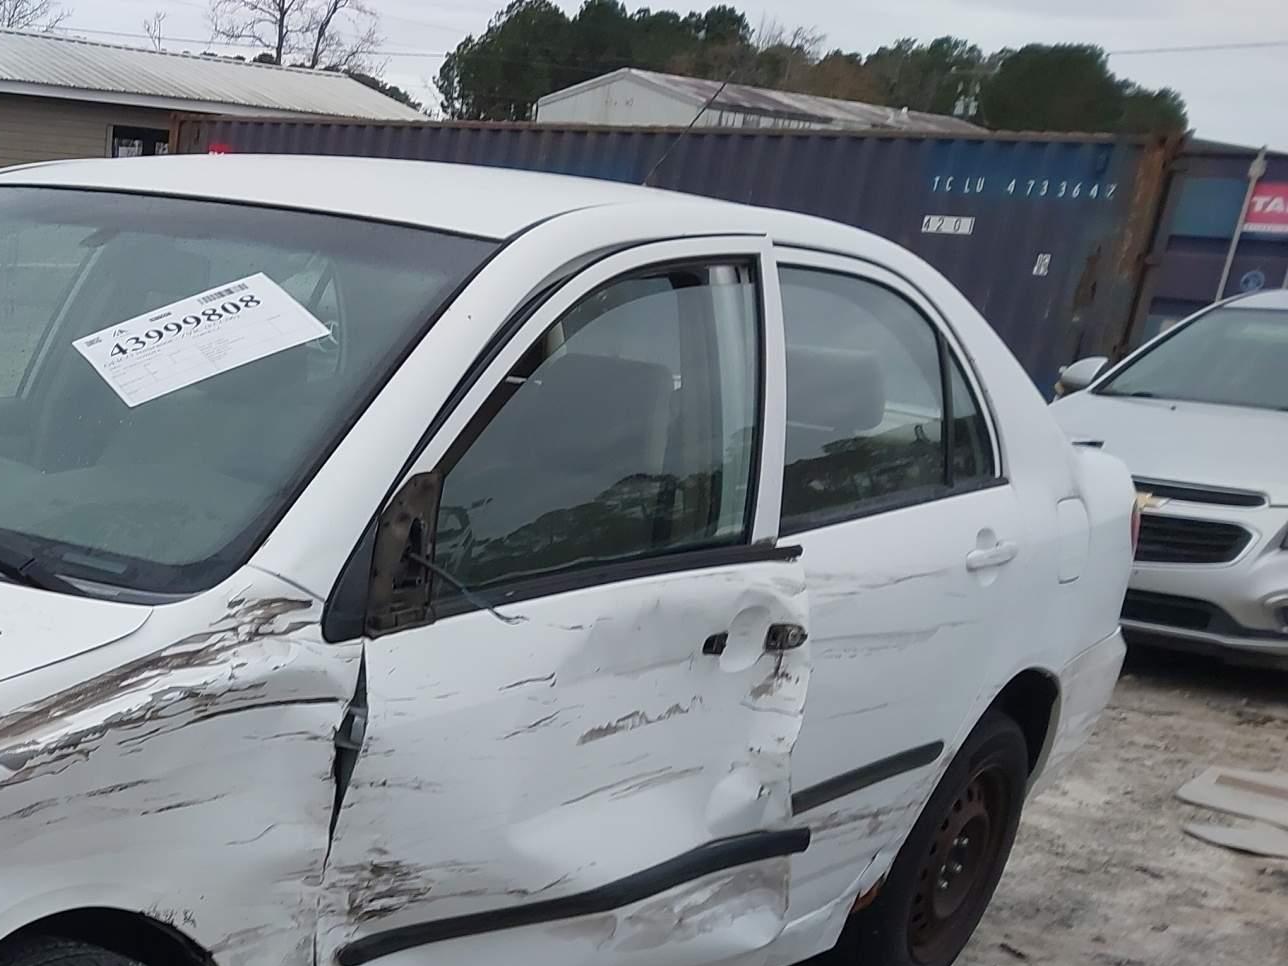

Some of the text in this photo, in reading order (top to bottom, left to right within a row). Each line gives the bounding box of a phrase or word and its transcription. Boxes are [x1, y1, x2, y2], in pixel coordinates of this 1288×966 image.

[932, 176, 985, 193] TCLU
[1251, 195, 1288, 214] TA
[110, 294, 261, 357] 43999808
